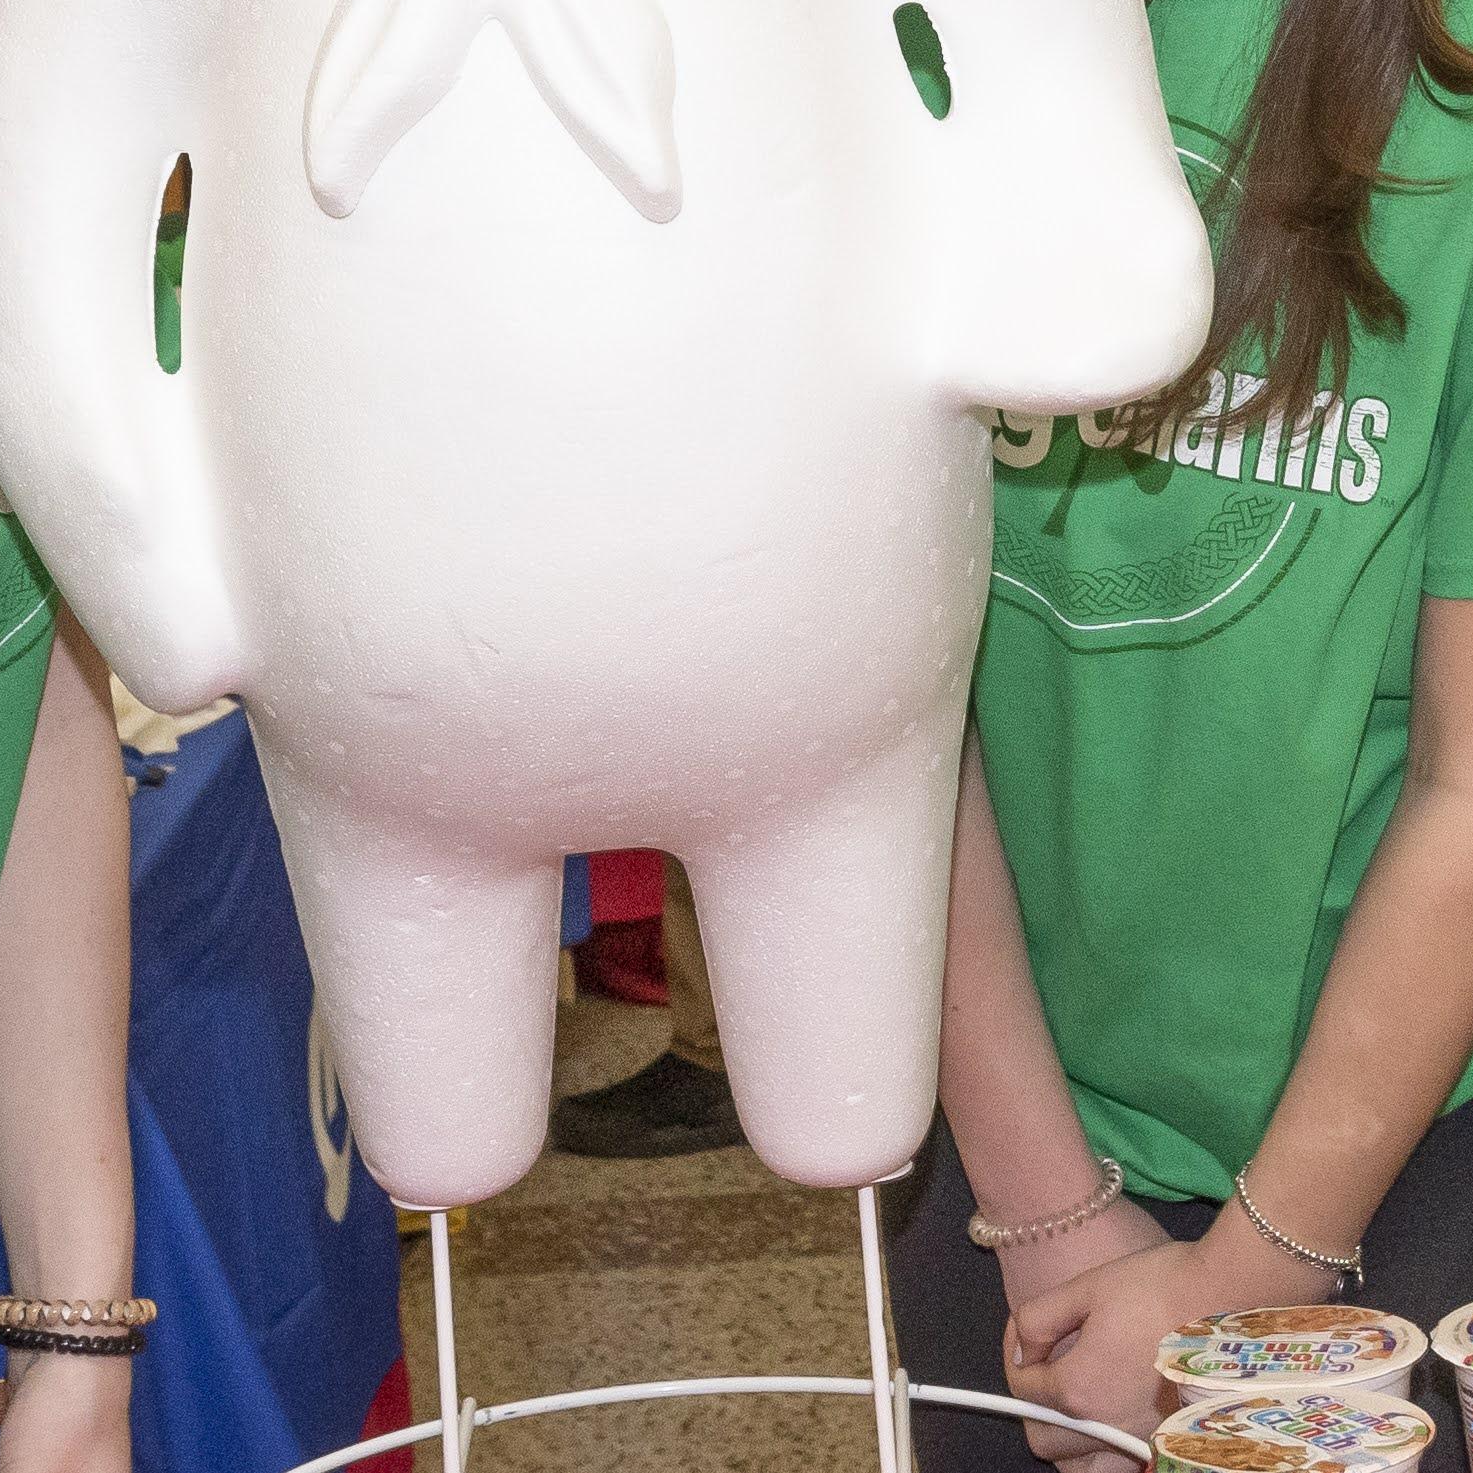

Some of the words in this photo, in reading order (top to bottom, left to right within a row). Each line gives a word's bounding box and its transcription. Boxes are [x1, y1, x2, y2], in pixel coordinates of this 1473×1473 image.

[1216, 1341, 1361, 1355] Crunch
[1238, 1352, 1334, 1365] Toast
[1201, 1360, 1355, 1373] Cinnamon
[1299, 1394, 1406, 1437] Cinnamon
[1247, 1408, 1361, 1451] Crunch
